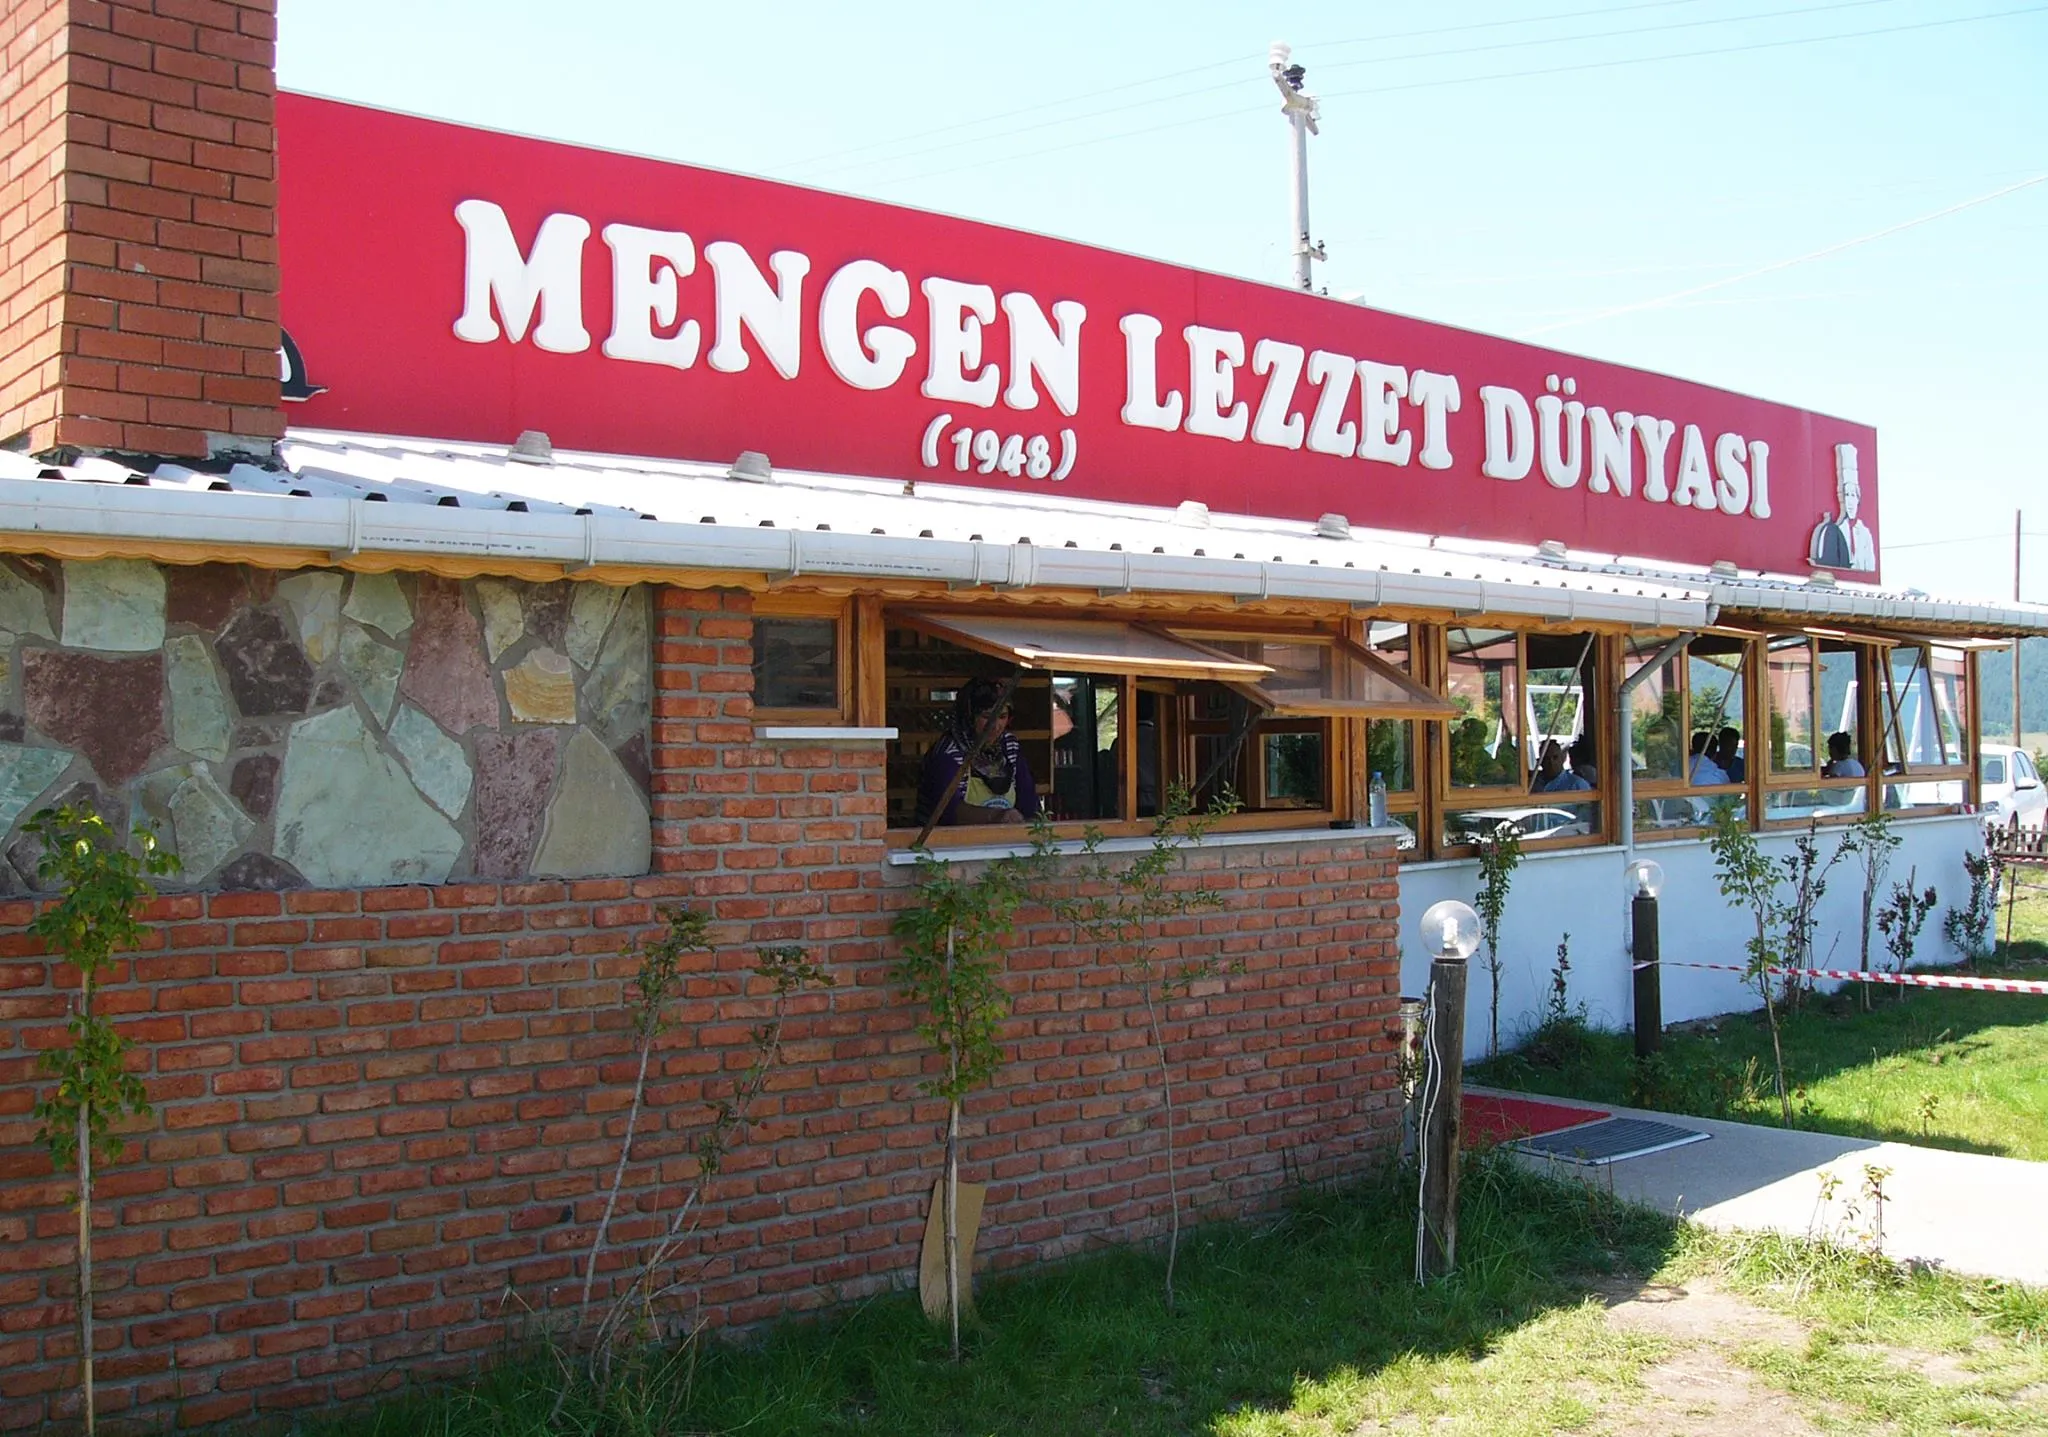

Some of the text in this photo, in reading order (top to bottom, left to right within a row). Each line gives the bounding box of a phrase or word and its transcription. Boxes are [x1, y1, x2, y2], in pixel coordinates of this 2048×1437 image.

[453, 199, 1773, 520] MENGEN LEZZET DÜNYASI
[922, 413, 1078, 482] (1948)
